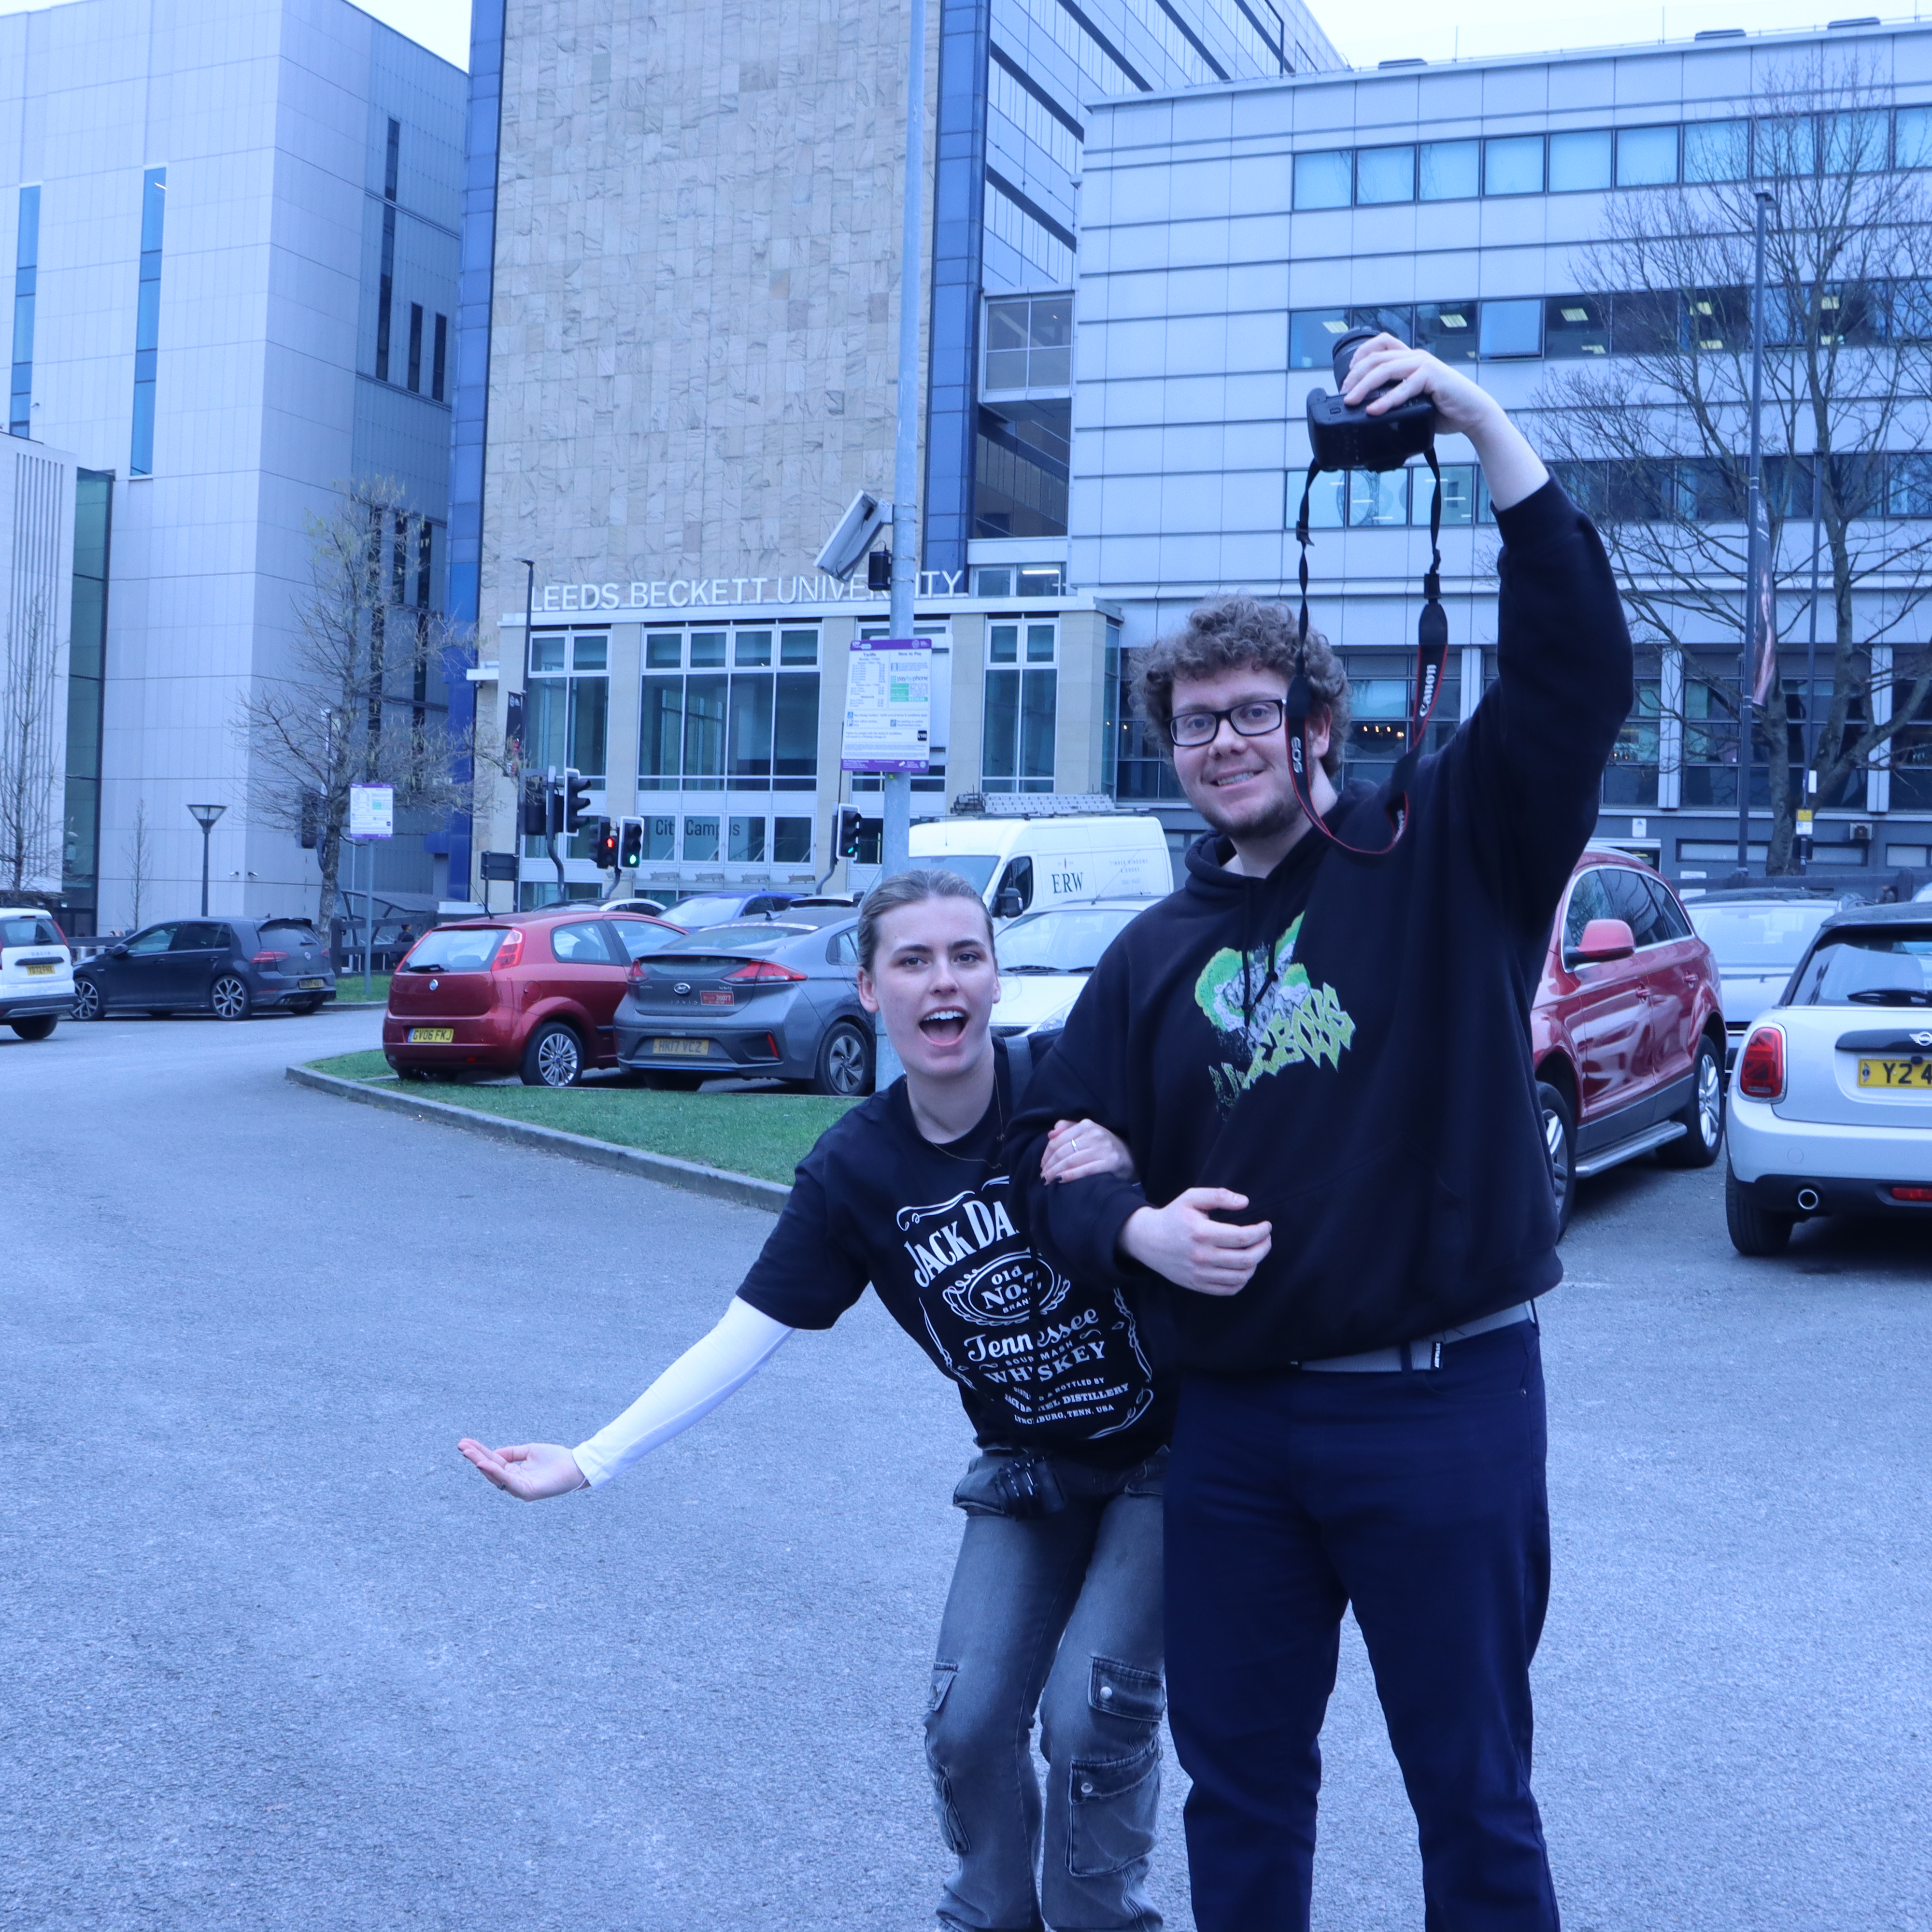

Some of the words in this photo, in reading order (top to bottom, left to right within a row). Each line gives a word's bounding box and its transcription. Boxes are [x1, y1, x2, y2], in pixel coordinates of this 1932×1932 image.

[531, 582, 621, 611] LEEDS
[630, 577, 768, 608] BECKETT
[777, 569, 963, 604] UNIVEITY
[1419, 664, 1437, 717] Canon
[1291, 736, 1303, 773] EOS
[655, 819, 675, 836] Cit
[1051, 871, 1084, 894] ERW
[904, 1220, 977, 1288] JACK
[1002, 1297, 1031, 1314] BRAN
[1040, 1339, 1073, 1361] MASH
[983, 1341, 1105, 1383] WHSKEY
[1062, 1382, 1129, 1405] DISTILLERY
[1066, 1407, 1094, 1418] TENN.
[1095, 1404, 1115, 1413] USA
